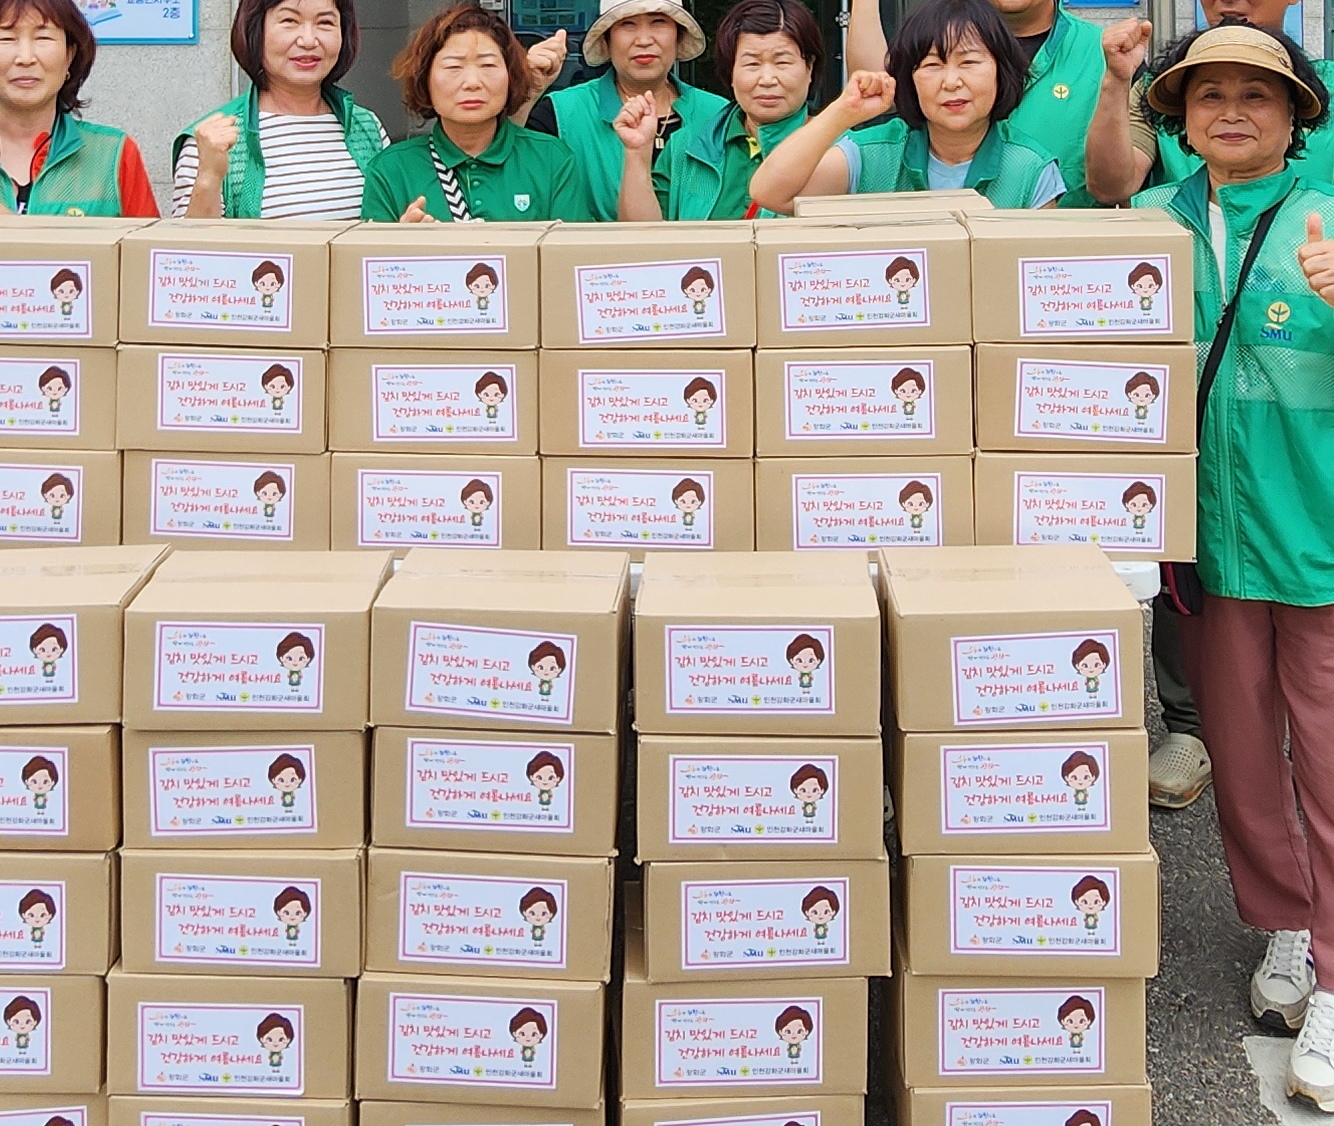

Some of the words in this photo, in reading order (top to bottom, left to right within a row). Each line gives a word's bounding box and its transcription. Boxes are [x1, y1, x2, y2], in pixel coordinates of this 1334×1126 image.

[162, 6, 181, 19] 2층
[158, 275, 175, 287] 김치
[178, 276, 209, 288] 맛있게
[213, 278, 236, 288] 드시고
[788, 280, 806, 291] 김치
[809, 278, 841, 290] 맛있게
[845, 278, 870, 288] 드시고
[11, 288, 35, 297] 드시고
[371, 283, 389, 295] 김치
[392, 283, 423, 294] 맛있게
[427, 283, 450, 293] 드시고
[584, 291, 603, 303] 김치
[606, 289, 637, 302] 맛있게
[641, 288, 666, 299] 드시고
[1028, 284, 1046, 296] 김치
[1050, 283, 1082, 295] 맛있게
[1086, 283, 1111, 293] 드시고
[168, 292, 208, 304] 건강하게
[383, 299, 423, 310] 건강하게
[800, 295, 841, 307] 건강하게
[597, 305, 638, 319] 건강하게
[1040, 300, 1082, 312] 건강하게
[1260, 325, 1293, 342] SMU
[165, 652, 185, 665] 김치
[189, 652, 225, 665] 맛있게
[230, 654, 258, 664] 드시고
[418, 652, 438, 666] 김치
[442, 654, 478, 669] 맛있게
[482, 659, 510, 671] 드시고
[675, 655, 695, 668] 김치
[699, 655, 735, 668] 맛있게
[740, 656, 768, 667] 드시고
[177, 671, 224, 683] 건강하게
[228, 670, 281, 684] 여름나세요
[961, 666, 982, 680] 김치
[986, 664, 1022, 678] 맛있게
[1026, 663, 1054, 675] 드시고
[429, 672, 476, 688] 건강하게
[480, 675, 532, 692] 여름나세요
[688, 674, 735, 686] 건강하게
[739, 673, 792, 686] 여름나세요
[975, 683, 1022, 697] 건강하게
[1026, 678, 1079, 694] 여름나세요
[417, 768, 437, 781] 김치
[441, 769, 476, 782] 맛있게
[481, 772, 508, 783] 드시고
[950, 775, 971, 788] 김치
[975, 774, 1011, 787] 맛있게
[1015, 774, 1043, 786] 드시고
[159, 778, 180, 791] 김치
[183, 776, 219, 790] 맛있게
[223, 777, 250, 788] 드시고
[429, 788, 475, 801] 건강하게
[479, 788, 532, 803] 여름나세요
[679, 785, 699, 798] 김치
[703, 785, 739, 797] 맛있게
[744, 786, 772, 797] 드시고
[964, 793, 1011, 806] 건강하게
[1015, 790, 1067, 804] 여름나세요
[173, 795, 219, 808] 건강하게
[222, 792, 274, 807] 여름나세요
[692, 804, 739, 816] 건강하게
[743, 803, 795, 815] 여름나세요
[960, 896, 980, 908] 김치
[984, 896, 1020, 908] 맛있게
[1025, 897, 1053, 908] 드시고
[973, 914, 1020, 927] 건강하게
[1024, 914, 1077, 927] 여름나세요
[665, 1029, 685, 1042] 김치
[689, 1028, 725, 1041] 맛있게
[730, 1028, 757, 1039] 드시고
[678, 1046, 724, 1059] 건강하게
[728, 1044, 780, 1058] 여름나세요
